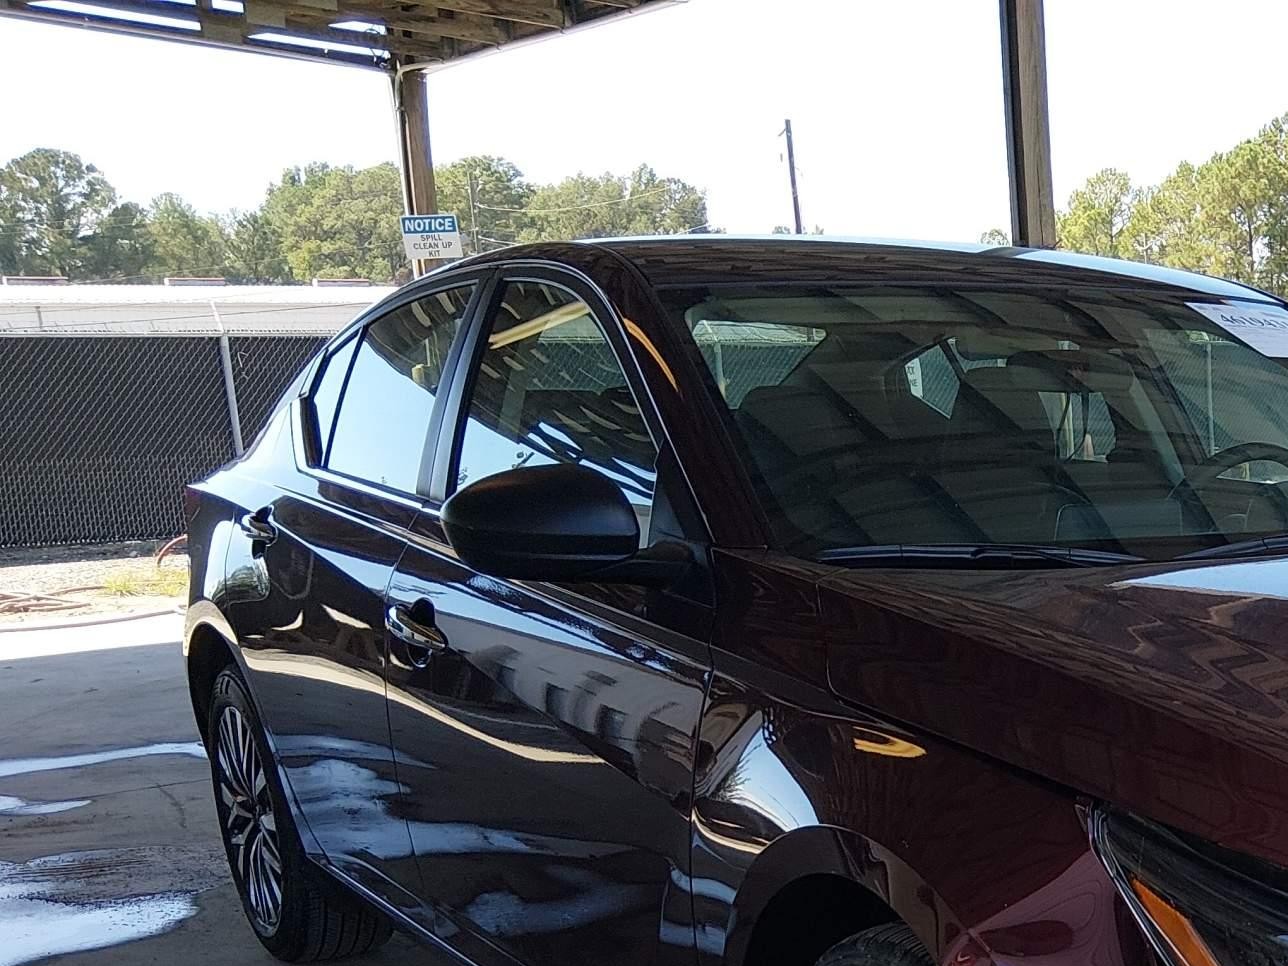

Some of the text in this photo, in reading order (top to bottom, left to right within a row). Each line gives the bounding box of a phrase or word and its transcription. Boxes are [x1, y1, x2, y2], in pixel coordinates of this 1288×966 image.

[405, 218, 453, 232] NOTICE
[420, 234, 443, 242] SPILL
[413, 241, 453, 250] CLEAN UP
[428, 249, 441, 257] KIT
